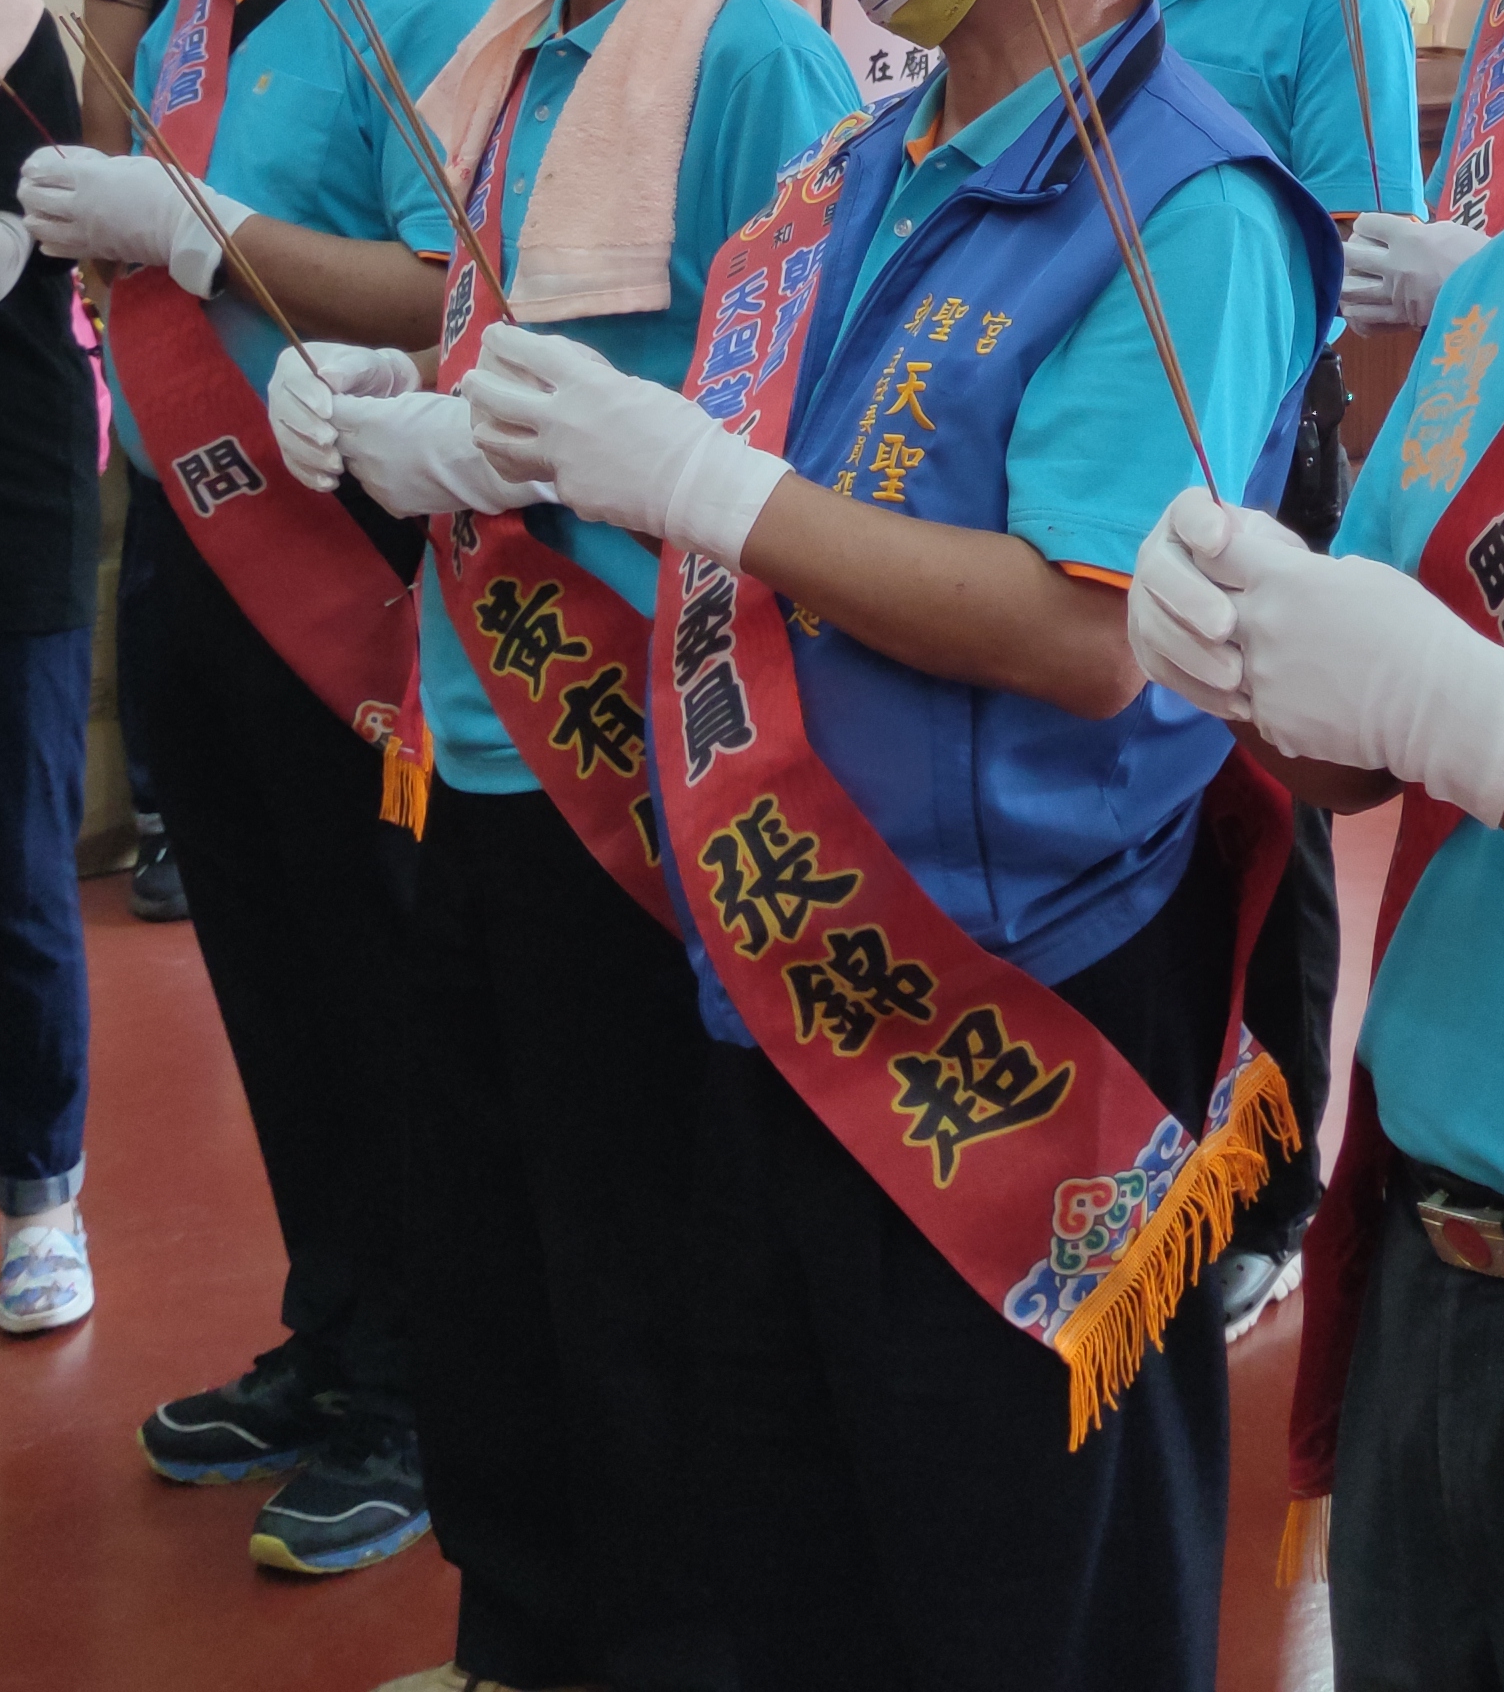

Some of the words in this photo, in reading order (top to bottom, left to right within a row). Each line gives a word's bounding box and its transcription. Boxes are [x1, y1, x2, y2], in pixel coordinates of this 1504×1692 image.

[865, 46, 929, 84] 在廟
[697, 269, 769, 423] 天聖堂
[172, 435, 266, 519] 問
[869, 360, 937, 504] 天聖
[698, 793, 1076, 1188] 張錦超
